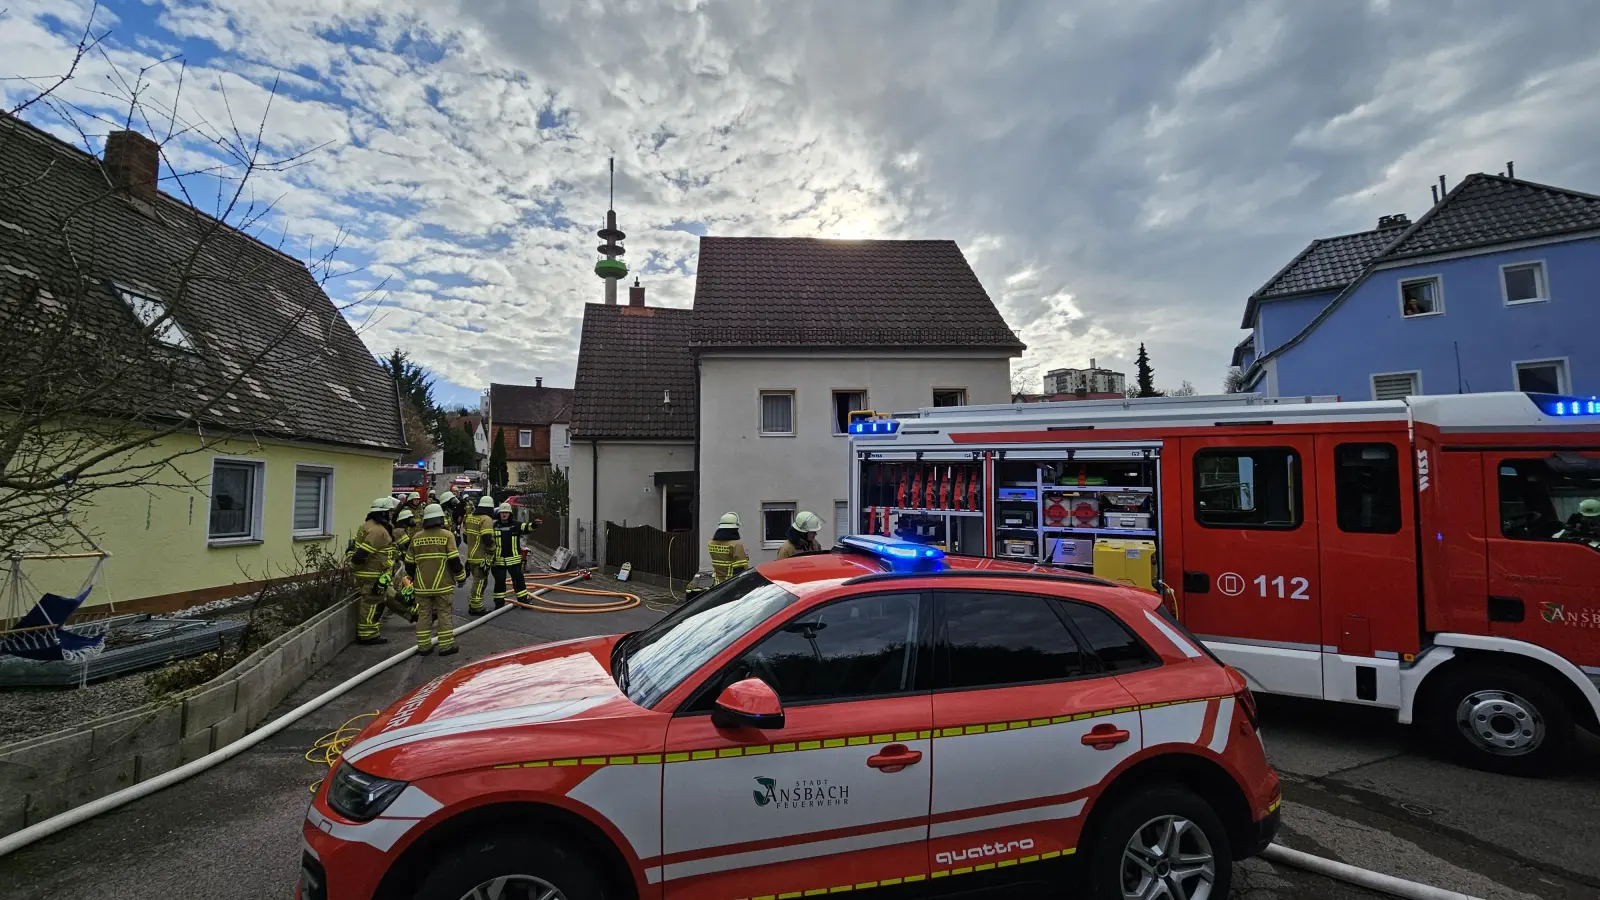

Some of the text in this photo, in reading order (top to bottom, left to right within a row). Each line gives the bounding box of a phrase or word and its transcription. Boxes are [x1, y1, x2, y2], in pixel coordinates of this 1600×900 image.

[1417, 449, 1429, 492] WISS
[1253, 574, 1310, 601] 112
[765, 785, 849, 802] ANSBACH
[795, 779, 829, 787] STADT
[776, 799, 849, 809] FEUERWEHR
[936, 838, 1034, 864] quattro
